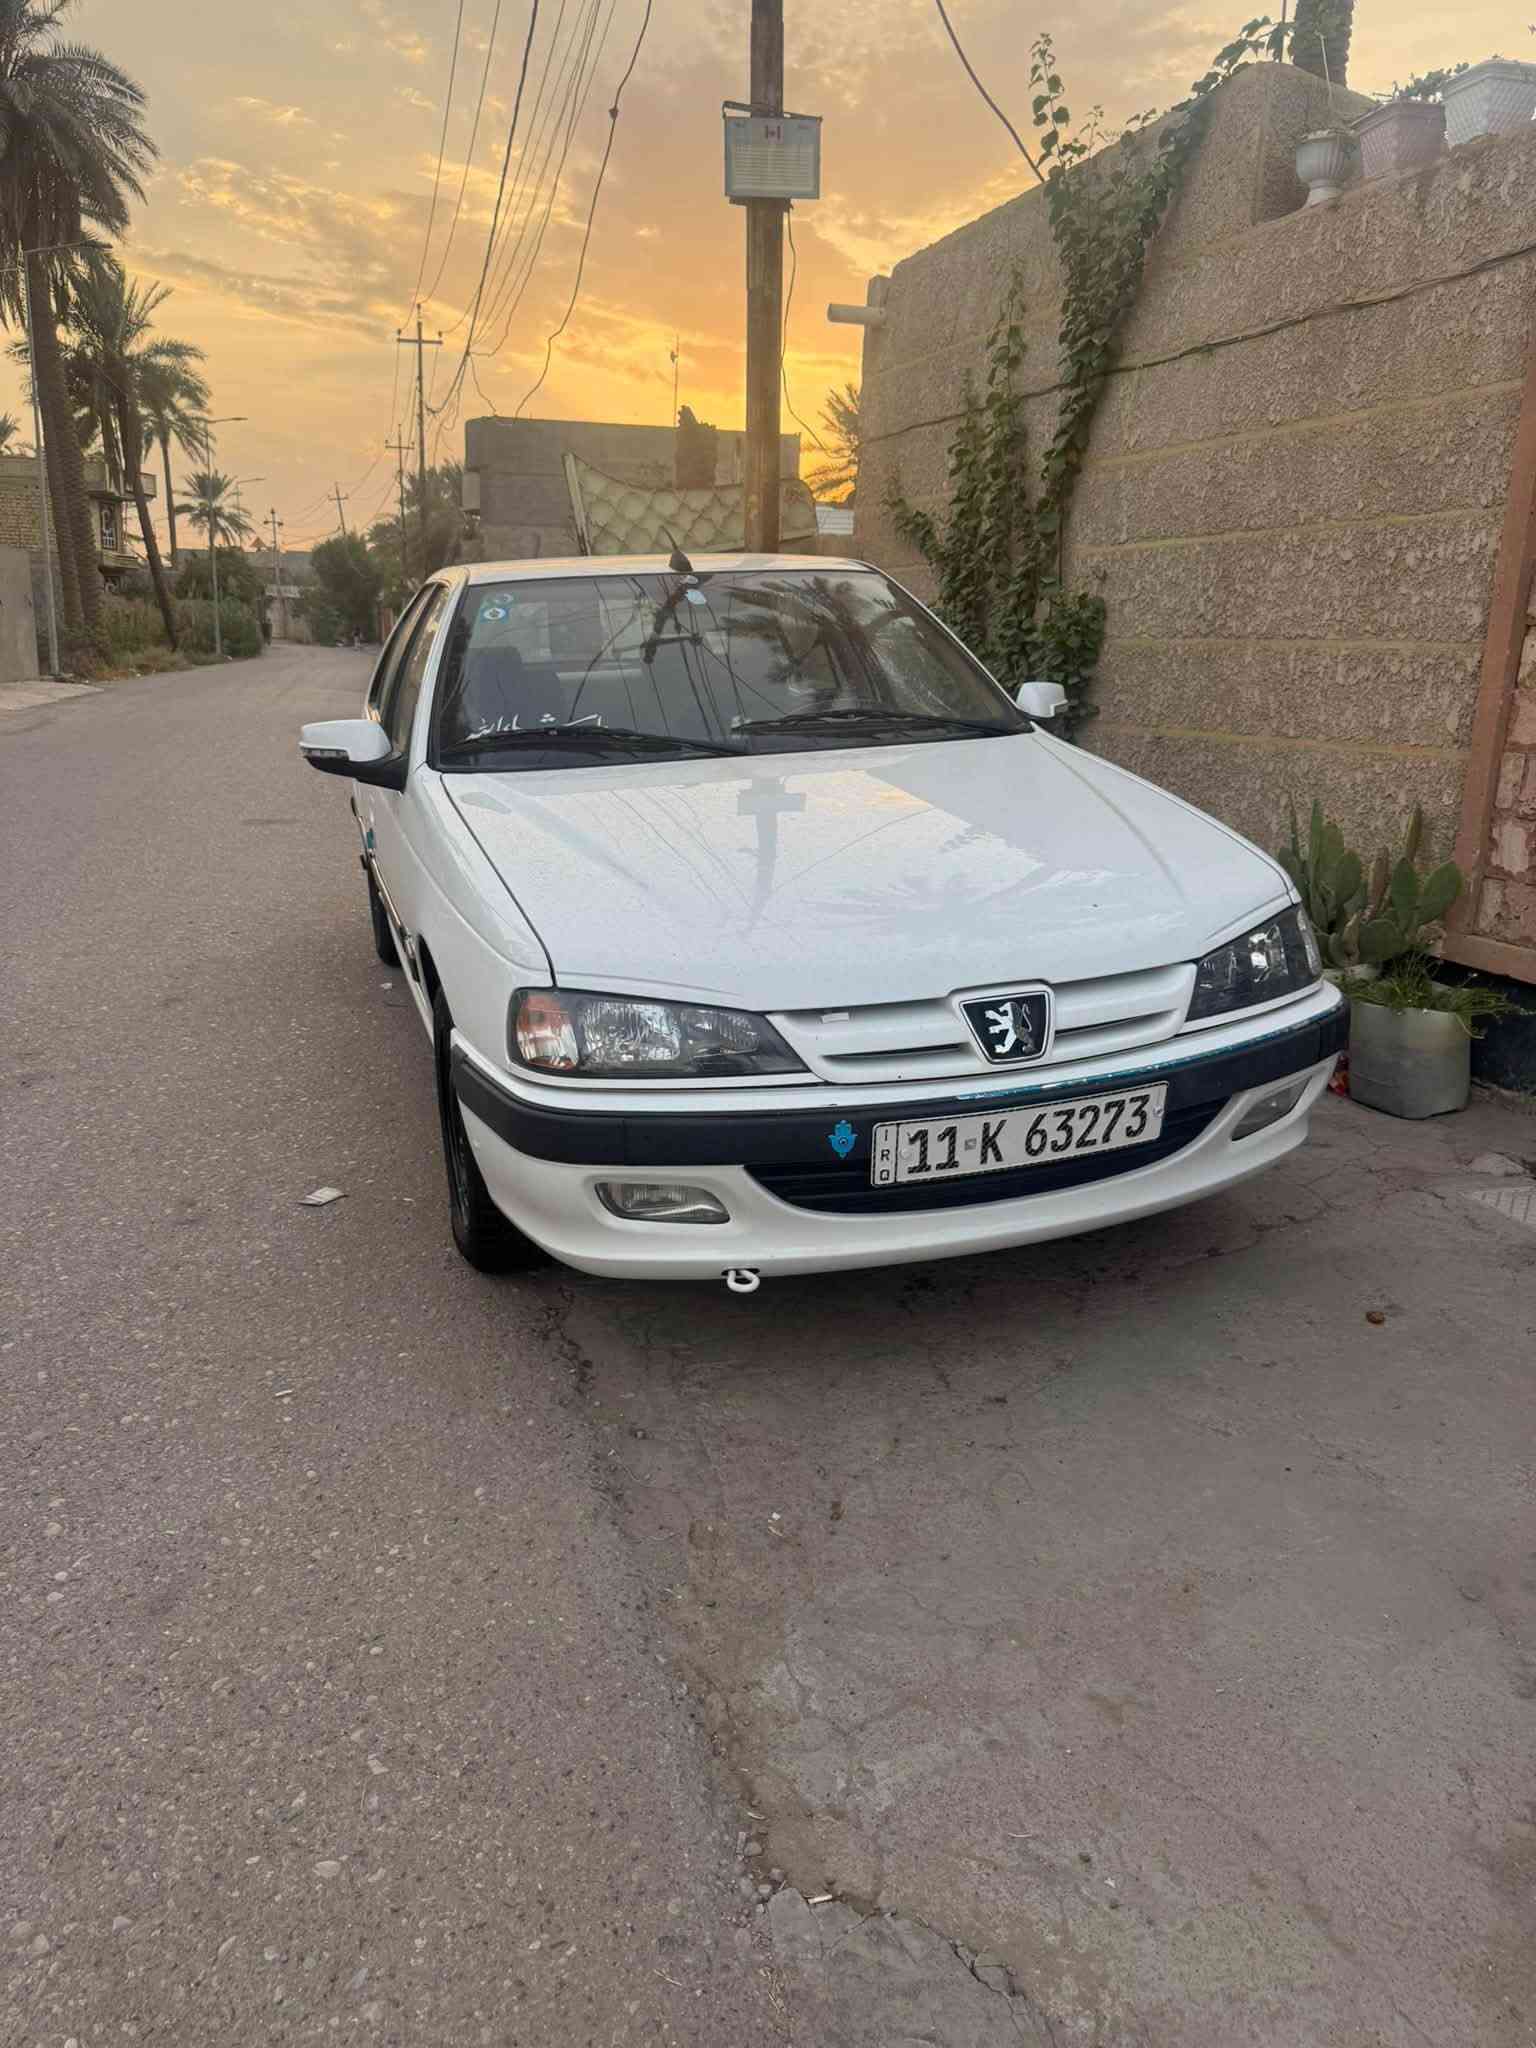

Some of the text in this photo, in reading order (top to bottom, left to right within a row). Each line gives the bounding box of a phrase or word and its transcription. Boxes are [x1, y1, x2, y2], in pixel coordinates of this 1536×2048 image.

[880, 1129, 890, 1181] IRQ
[908, 1094, 1151, 1174] 11 K 63273
